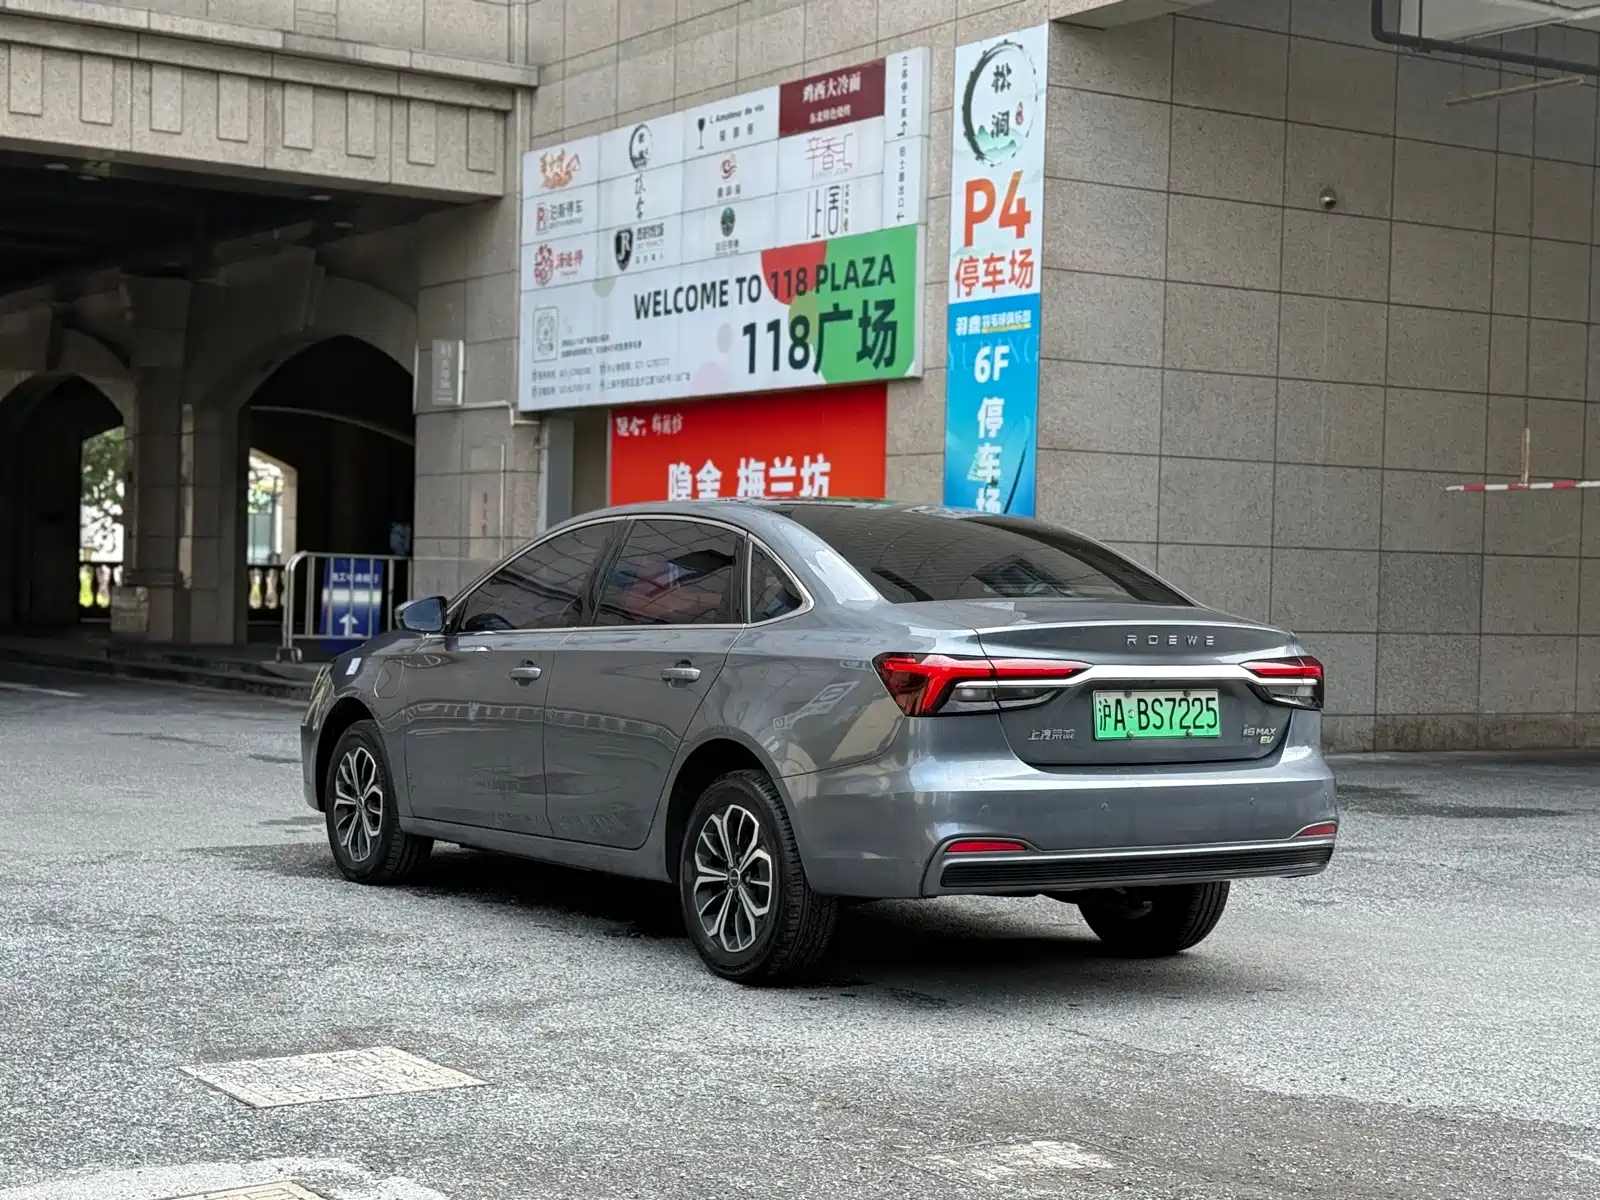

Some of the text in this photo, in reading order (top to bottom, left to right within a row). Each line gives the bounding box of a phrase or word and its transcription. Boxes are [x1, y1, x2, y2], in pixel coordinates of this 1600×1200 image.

[964, 170, 1032, 247] P4
[634, 254, 895, 320] WELCOME TO 118 PLAZA
[955, 248, 1034, 298] 停车场
[742, 298, 898, 376] 118广场
[974, 345, 1010, 384] 6F
[736, 452, 832, 499] 梅兰坊
[1126, 634, 1215, 646] ROEWE
[1260, 735, 1275, 744] EV
